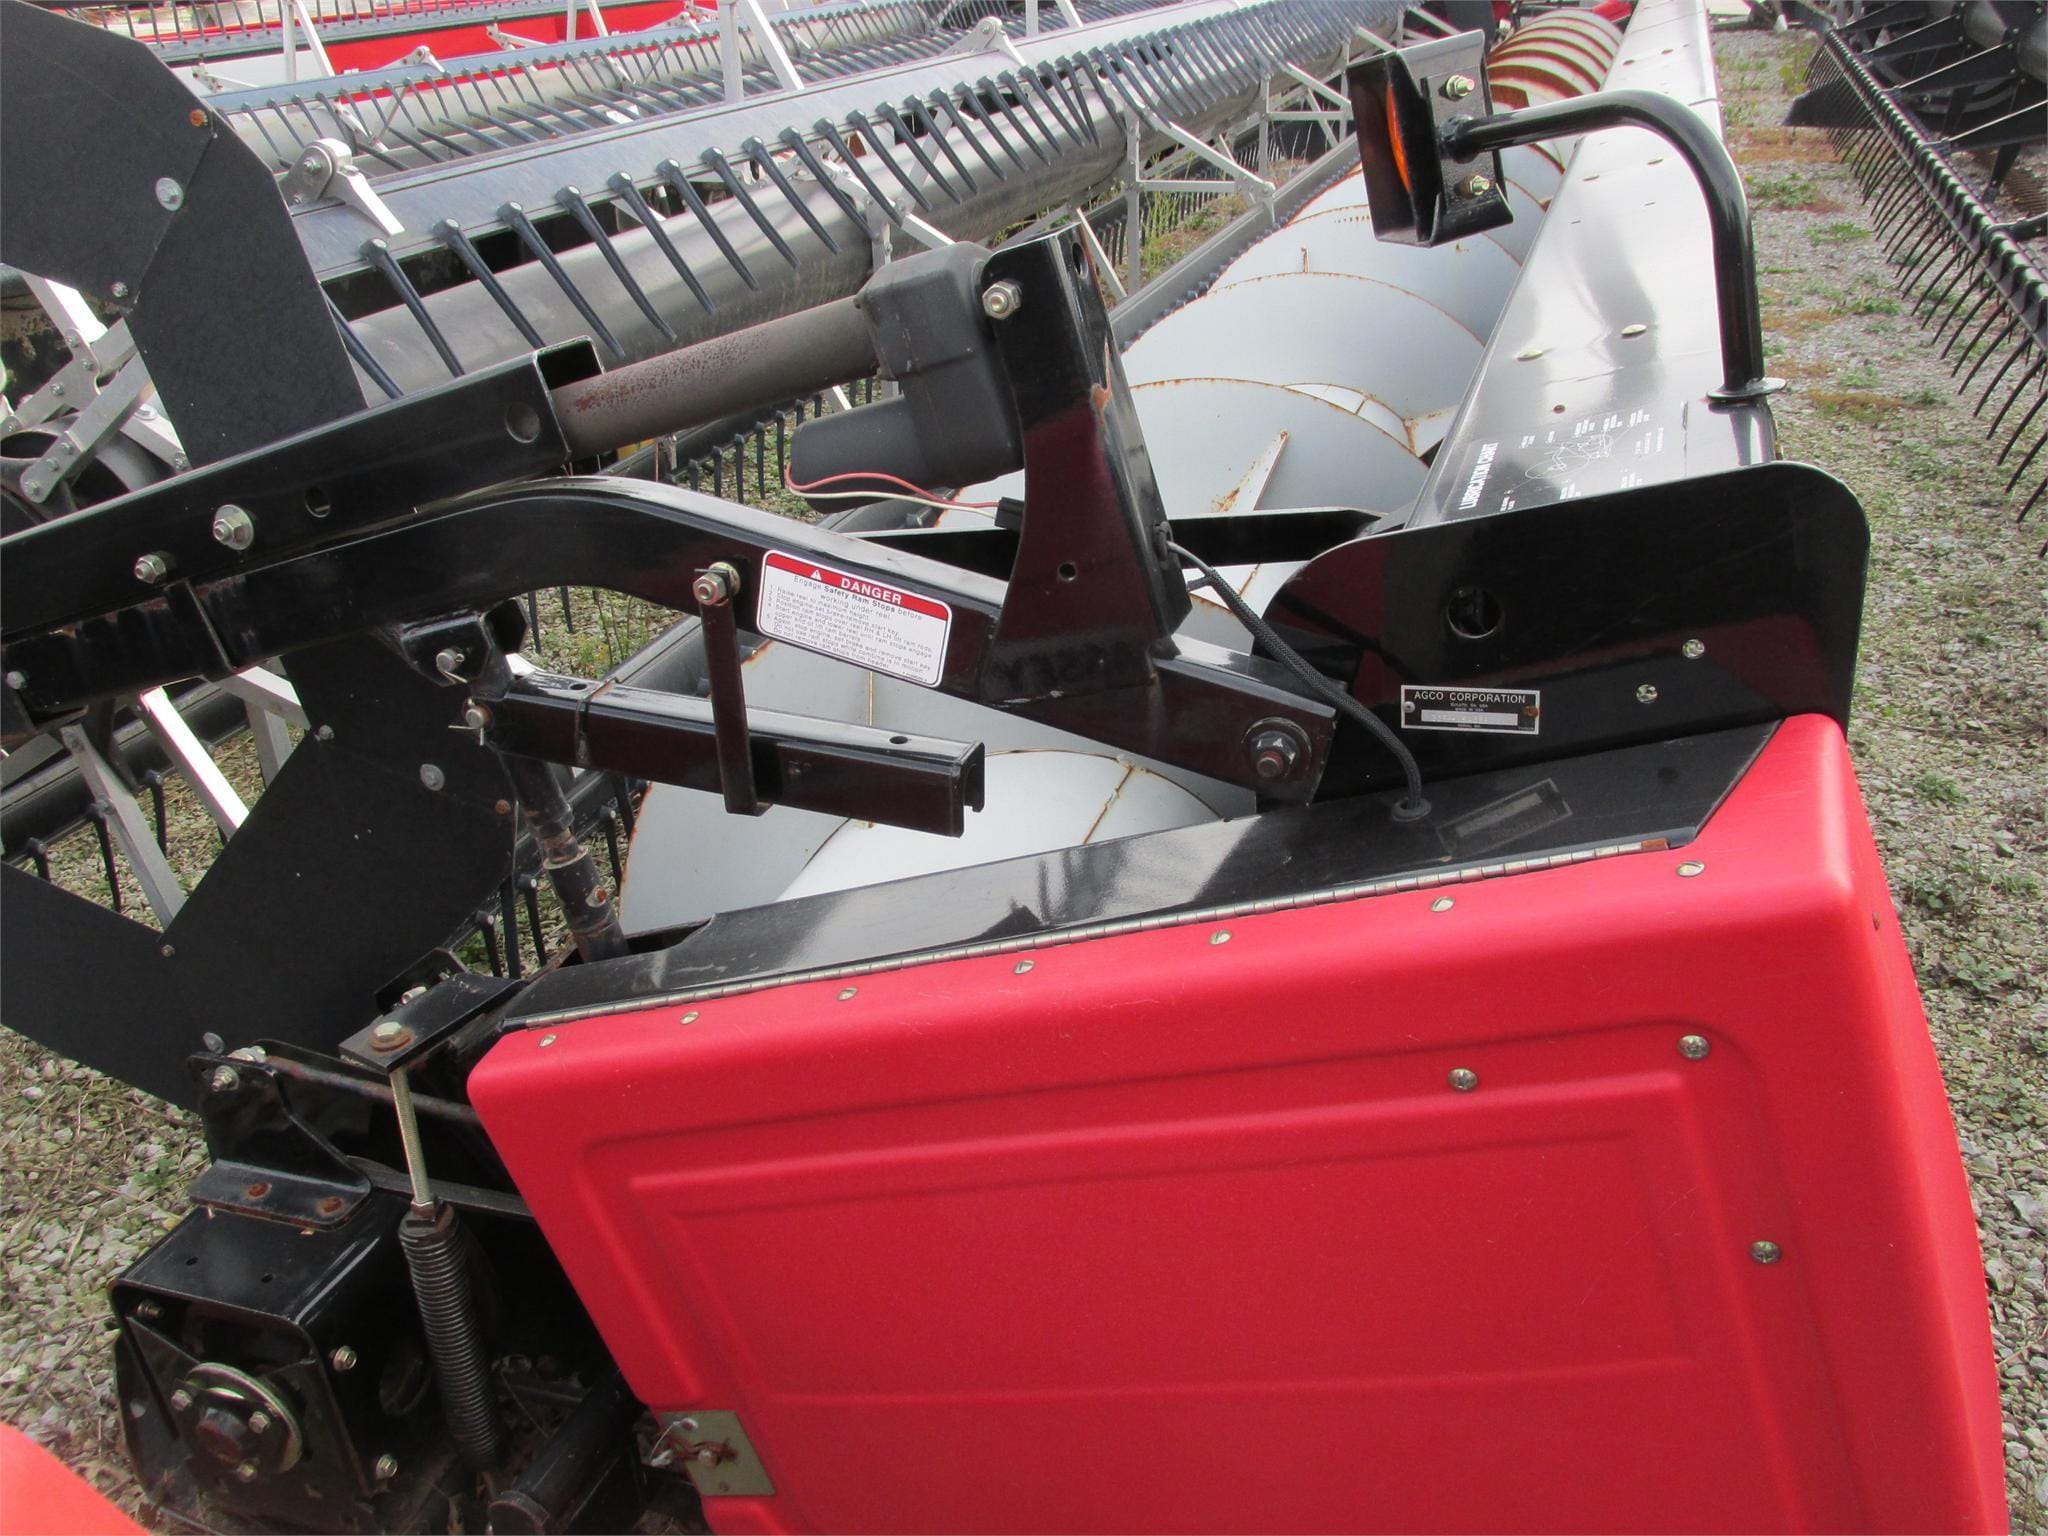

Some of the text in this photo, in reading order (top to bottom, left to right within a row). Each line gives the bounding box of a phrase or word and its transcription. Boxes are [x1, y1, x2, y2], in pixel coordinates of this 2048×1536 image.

[1458, 442, 1499, 510] LUBRICATION CHART
[793, 576, 921, 619] Engage Safety Ram Stops before
[841, 578, 901, 604] DANGER
[820, 595, 848, 607] working
[851, 604, 872, 614] under
[1414, 691, 1526, 704] AGCO CORPORATION
